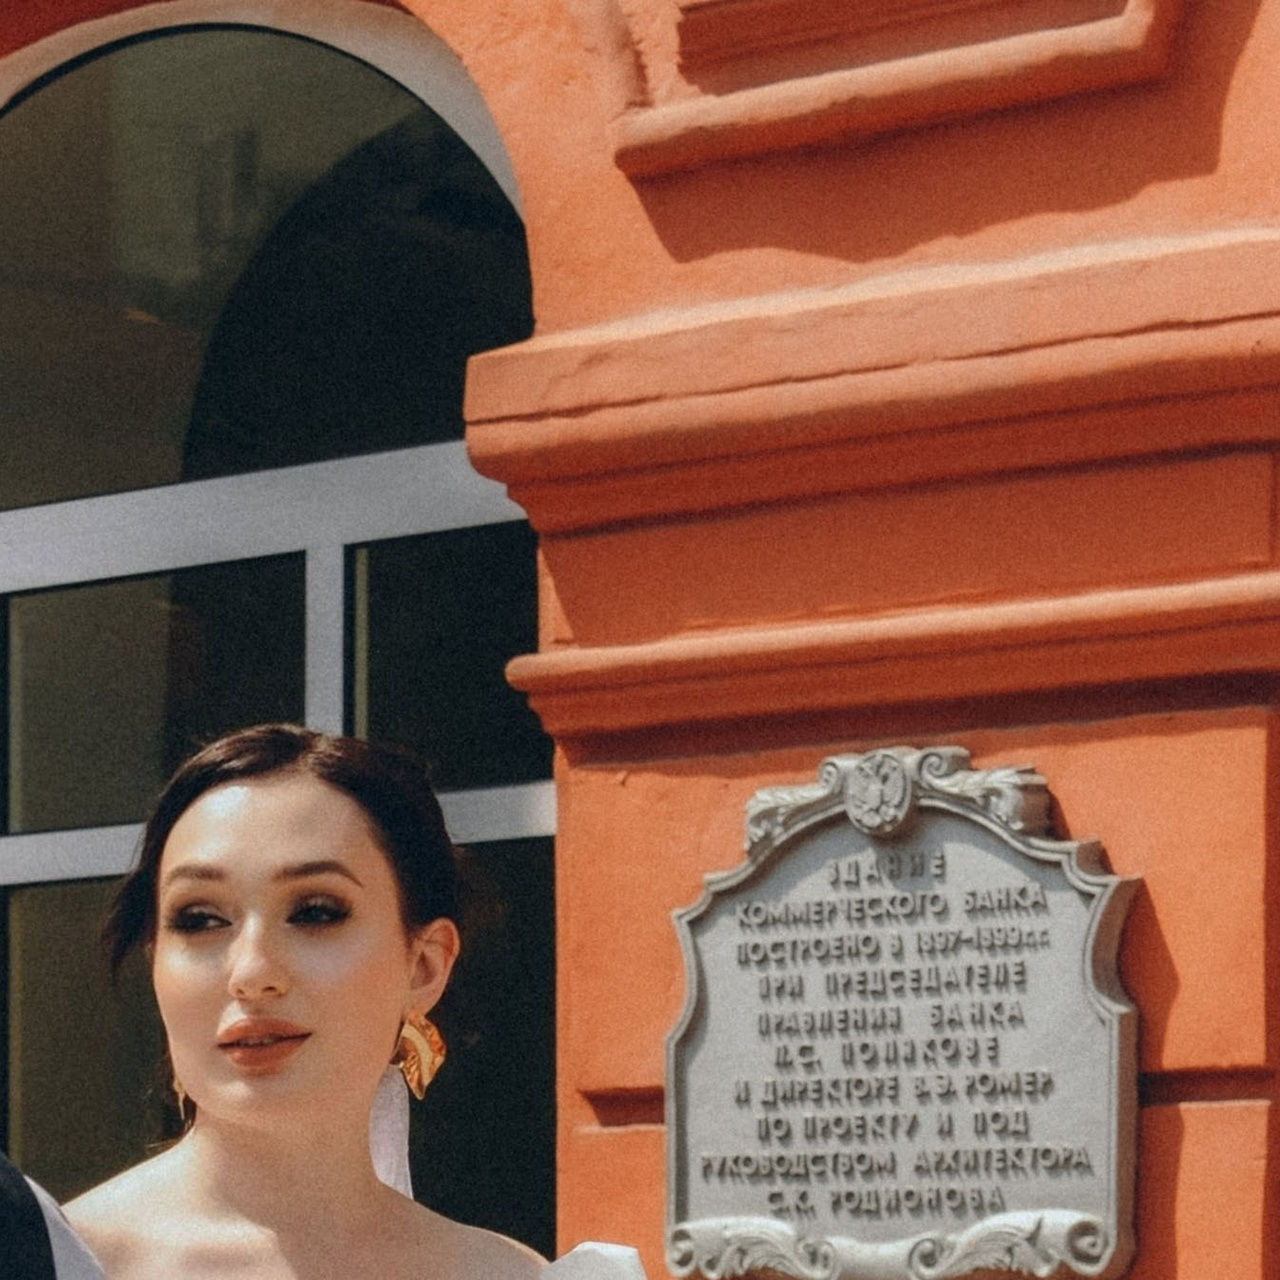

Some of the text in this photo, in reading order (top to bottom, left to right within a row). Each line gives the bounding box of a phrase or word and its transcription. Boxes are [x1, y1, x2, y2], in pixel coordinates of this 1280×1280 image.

[828, 851, 947, 889] ЗДАНИЕ
[734, 886, 1049, 929] КОММЕРЧЕСКОГО БАНКА
[736, 934, 880, 968] ПОСТРОЕНО
[889, 934, 904, 958] В
[758, 962, 1027, 1000] ПРИ ПРЕДСЕДАТЕЛЕ
[758, 1001, 1026, 1038] ПРАВЛЕНИЯ БАНКА
[841, 1037, 1001, 1068] ПОЛЯКОВЕ
[733, 1079, 752, 1105] И
[760, 1075, 901, 1108] ДИРЕКТОРЕ
[964, 1071, 1056, 1100] РОМЕР
[756, 1109, 1031, 1141] ПО ПРОЕКТУ И ПОД
[700, 1147, 1095, 1184] РУКОВОДСТВОМ АРХИТЕКТОРА
[831, 1185, 1007, 1214] РОДИОНОВА
